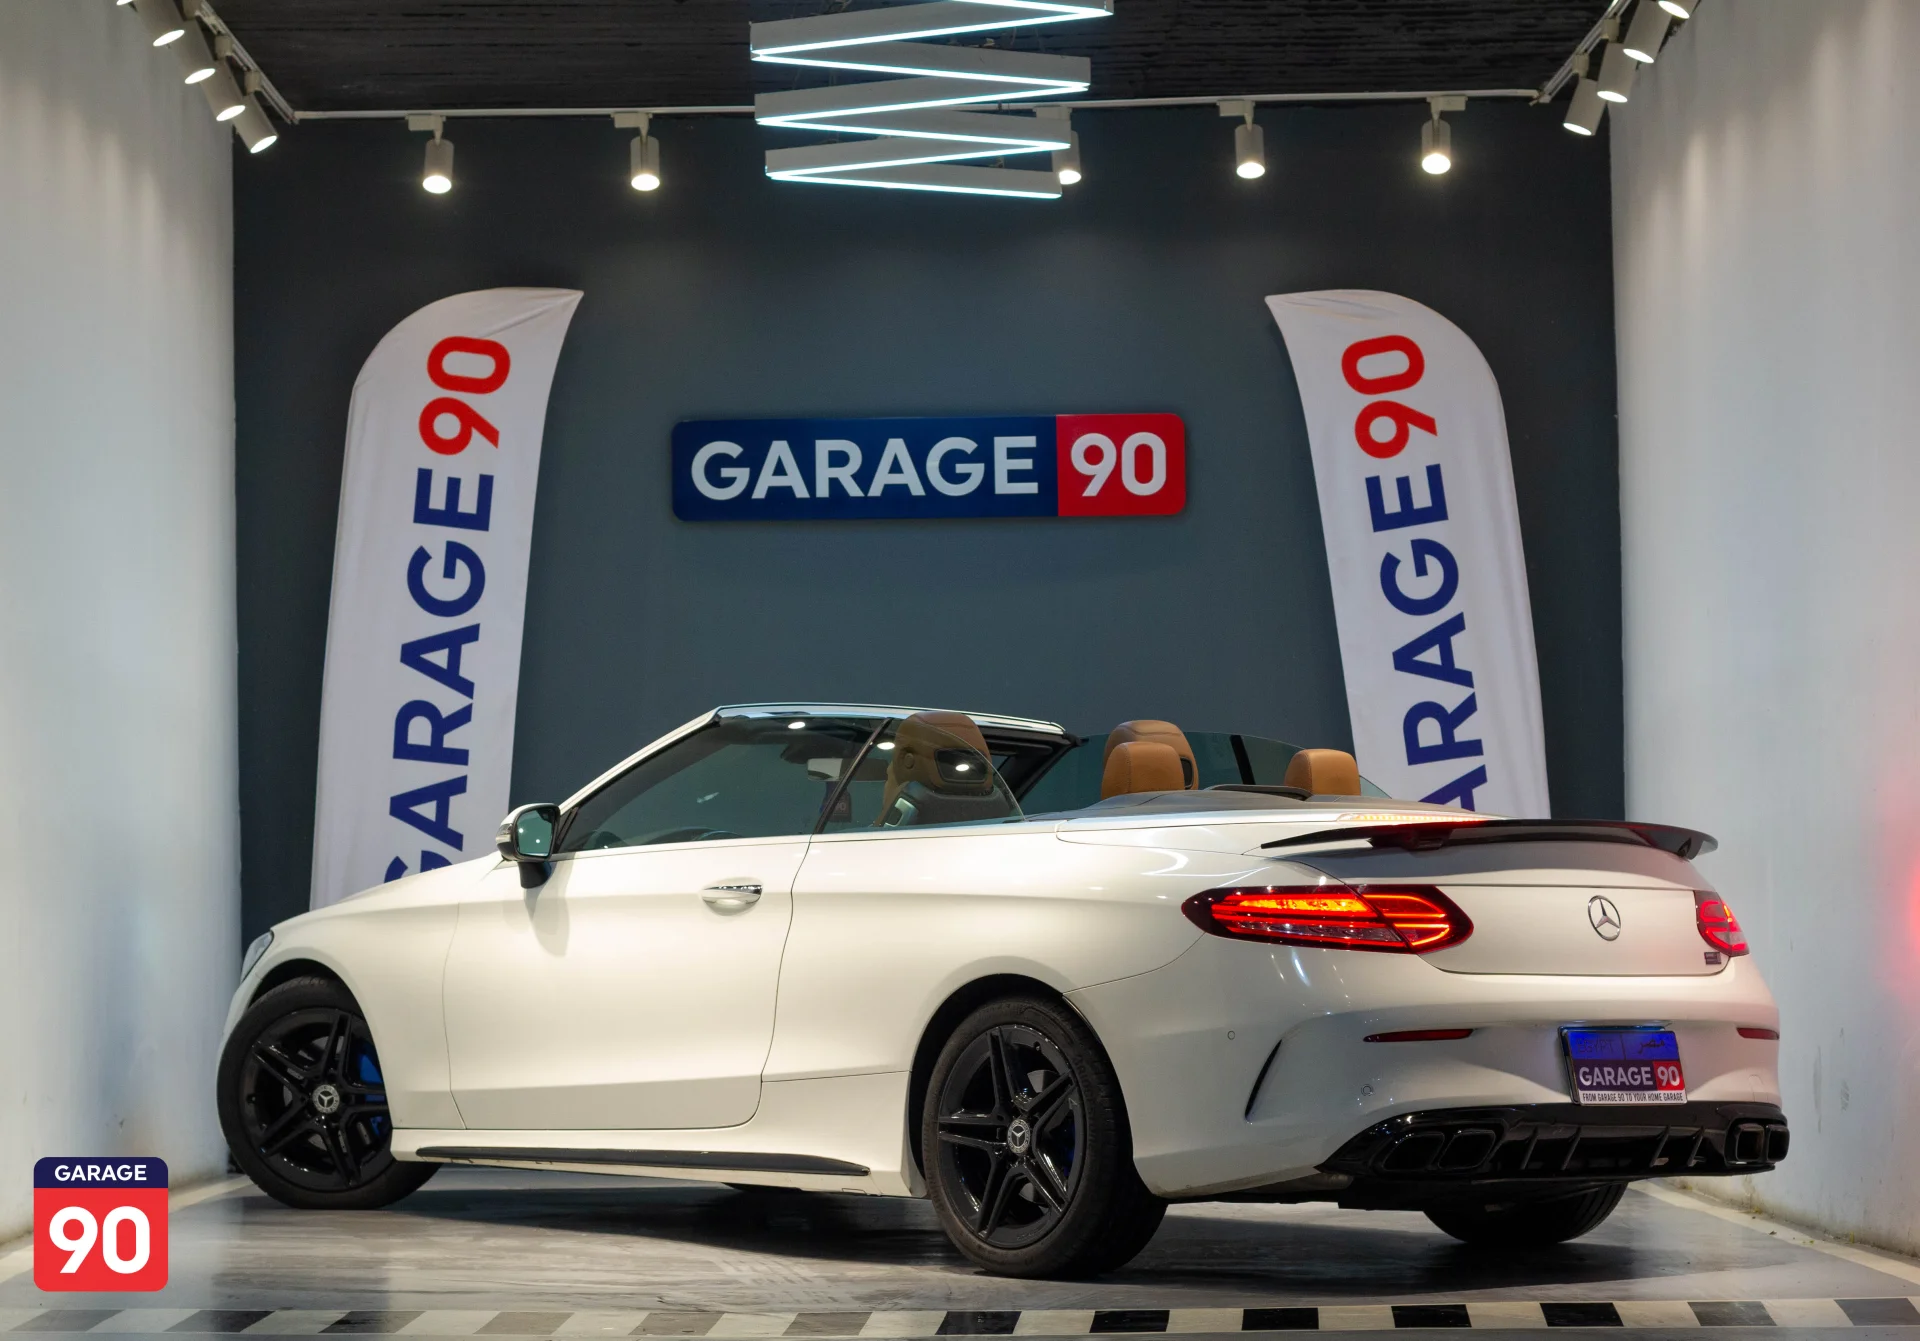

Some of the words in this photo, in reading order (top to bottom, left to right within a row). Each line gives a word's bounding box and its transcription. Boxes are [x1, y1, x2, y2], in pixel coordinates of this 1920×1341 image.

[418, 336, 511, 456] 90
[1341, 334, 1437, 459] 90
[691, 435, 1038, 500] GARAGE
[1071, 431, 1167, 497] 90
[1575, 1037, 1615, 1053] EGYPT
[1637, 1037, 1665, 1054] مصر
[1579, 1066, 1654, 1087] GARAGE
[1657, 1065, 1681, 1087] 90
[1582, 1093, 1597, 1102] FROM
[1597, 1093, 1617, 1102] GARAGE
[1625, 1093, 1633, 1102] TO
[1633, 1092, 1647, 1101] YOUR
[1647, 1092, 1662, 1101] HOME
[1663, 1092, 1684, 1101] GARAGE
